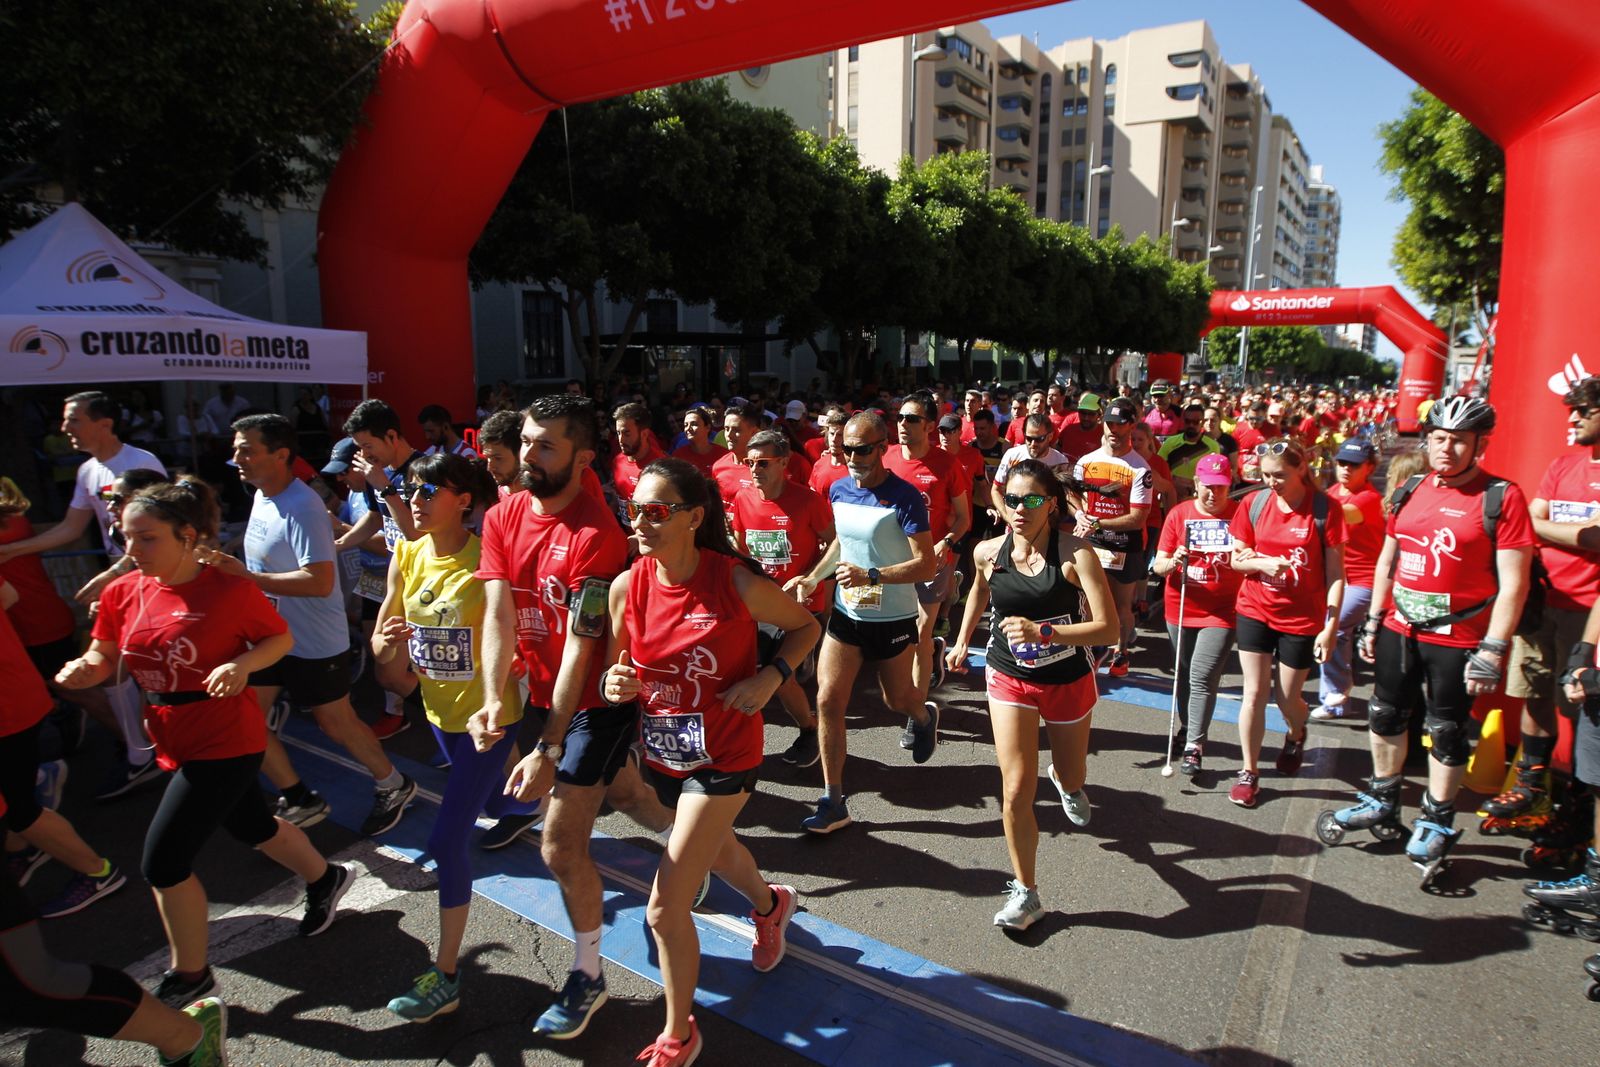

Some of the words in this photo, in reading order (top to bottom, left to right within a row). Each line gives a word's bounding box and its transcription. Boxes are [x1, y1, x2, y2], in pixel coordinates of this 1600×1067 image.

[1251, 295, 1335, 311] Santander
[255, 360, 311, 371] deportivo
[1190, 529, 1226, 541] 2185
[750, 541, 781, 552] 1304
[411, 639, 460, 662] 2168
[644, 728, 692, 752] 2203
